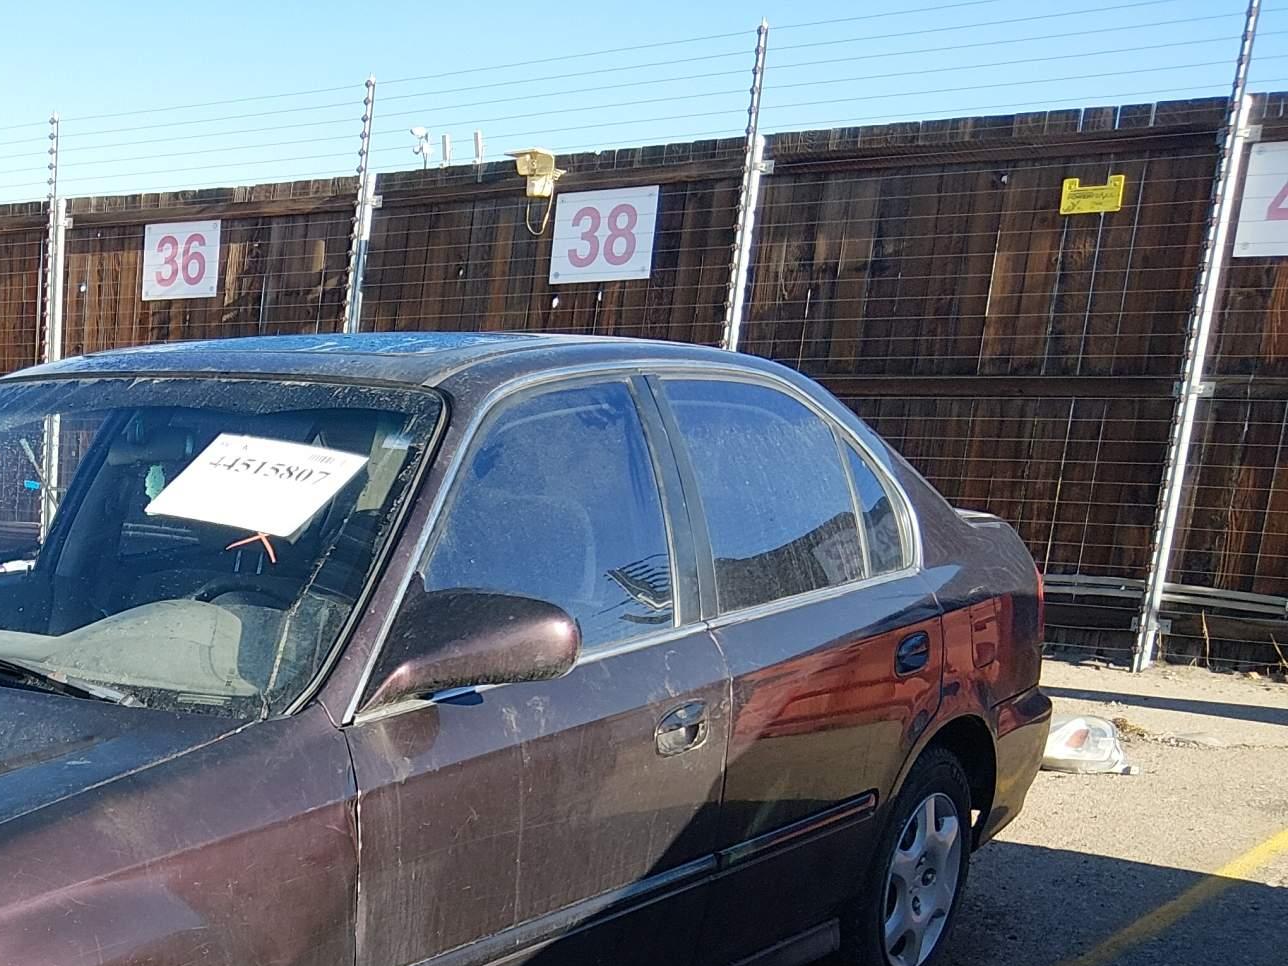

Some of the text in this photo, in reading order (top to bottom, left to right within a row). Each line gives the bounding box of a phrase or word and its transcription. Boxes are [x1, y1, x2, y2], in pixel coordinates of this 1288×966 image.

[155, 233, 206, 287] 36
[568, 203, 638, 268] 38
[209, 455, 332, 485] 44515807
